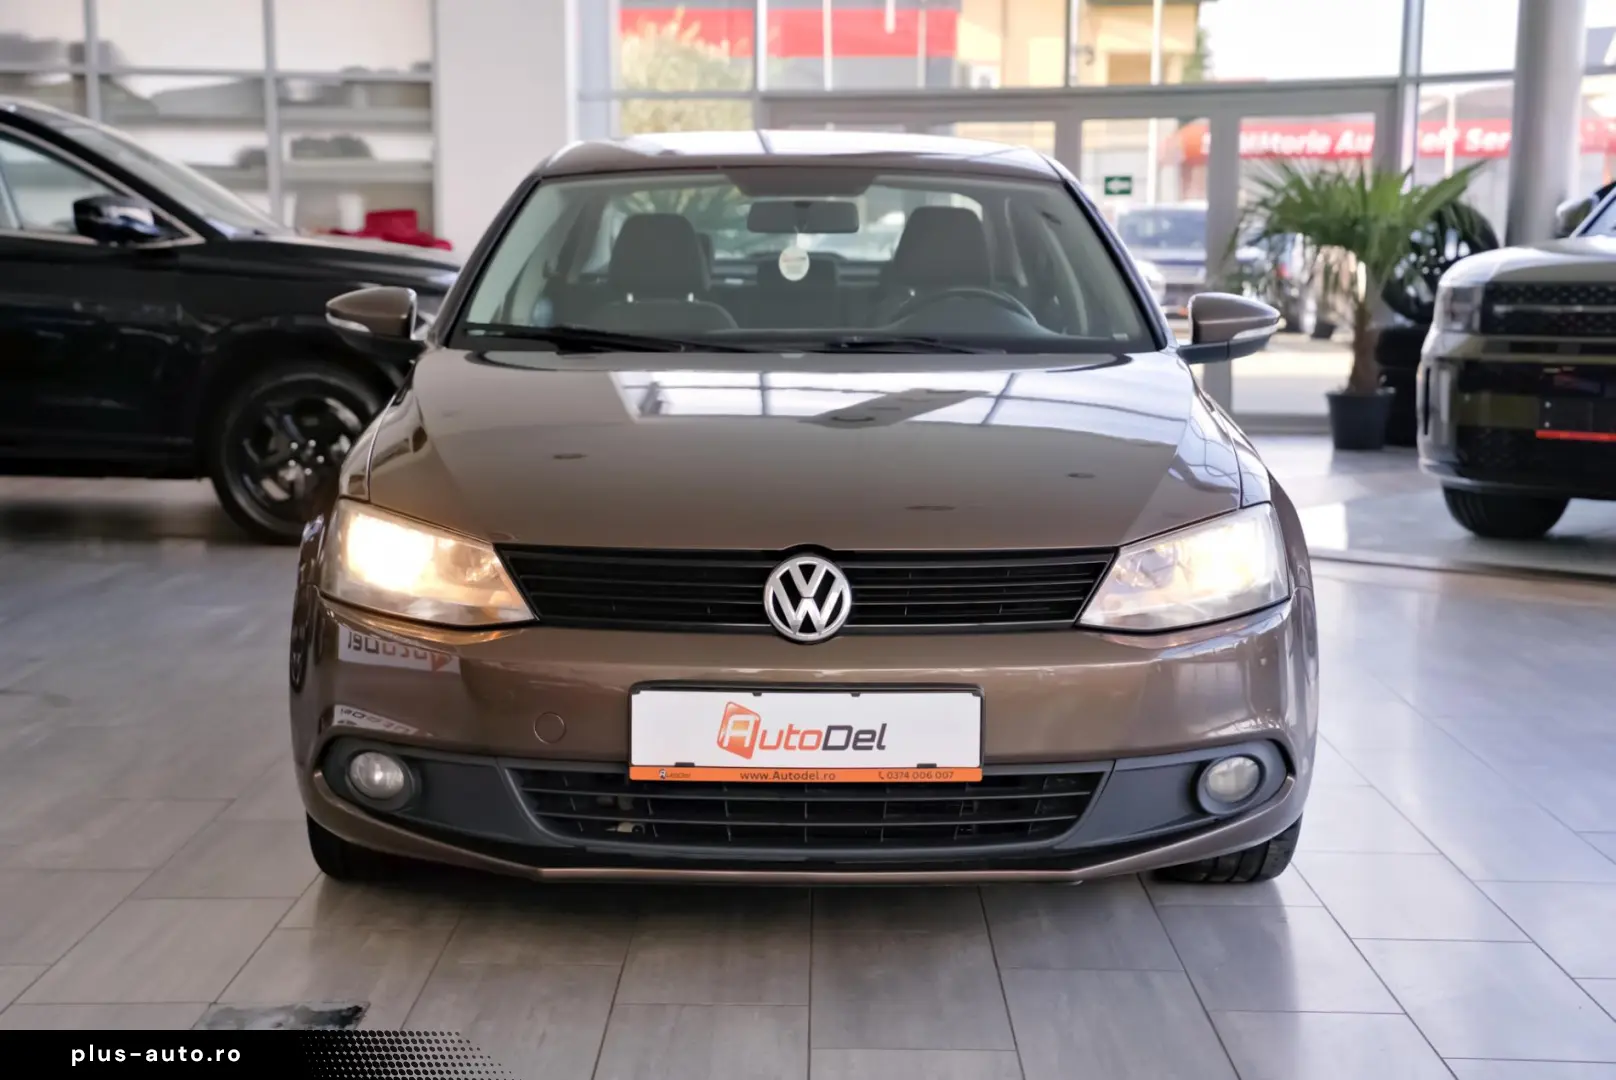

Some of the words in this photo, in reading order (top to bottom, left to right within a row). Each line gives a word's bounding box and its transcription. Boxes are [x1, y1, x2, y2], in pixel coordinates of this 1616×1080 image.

[719, 706, 888, 755] AutoDel
[740, 770, 836, 781] www.Autodel.ro
[886, 770, 912, 780] 0374
[914, 770, 933, 780] 006
